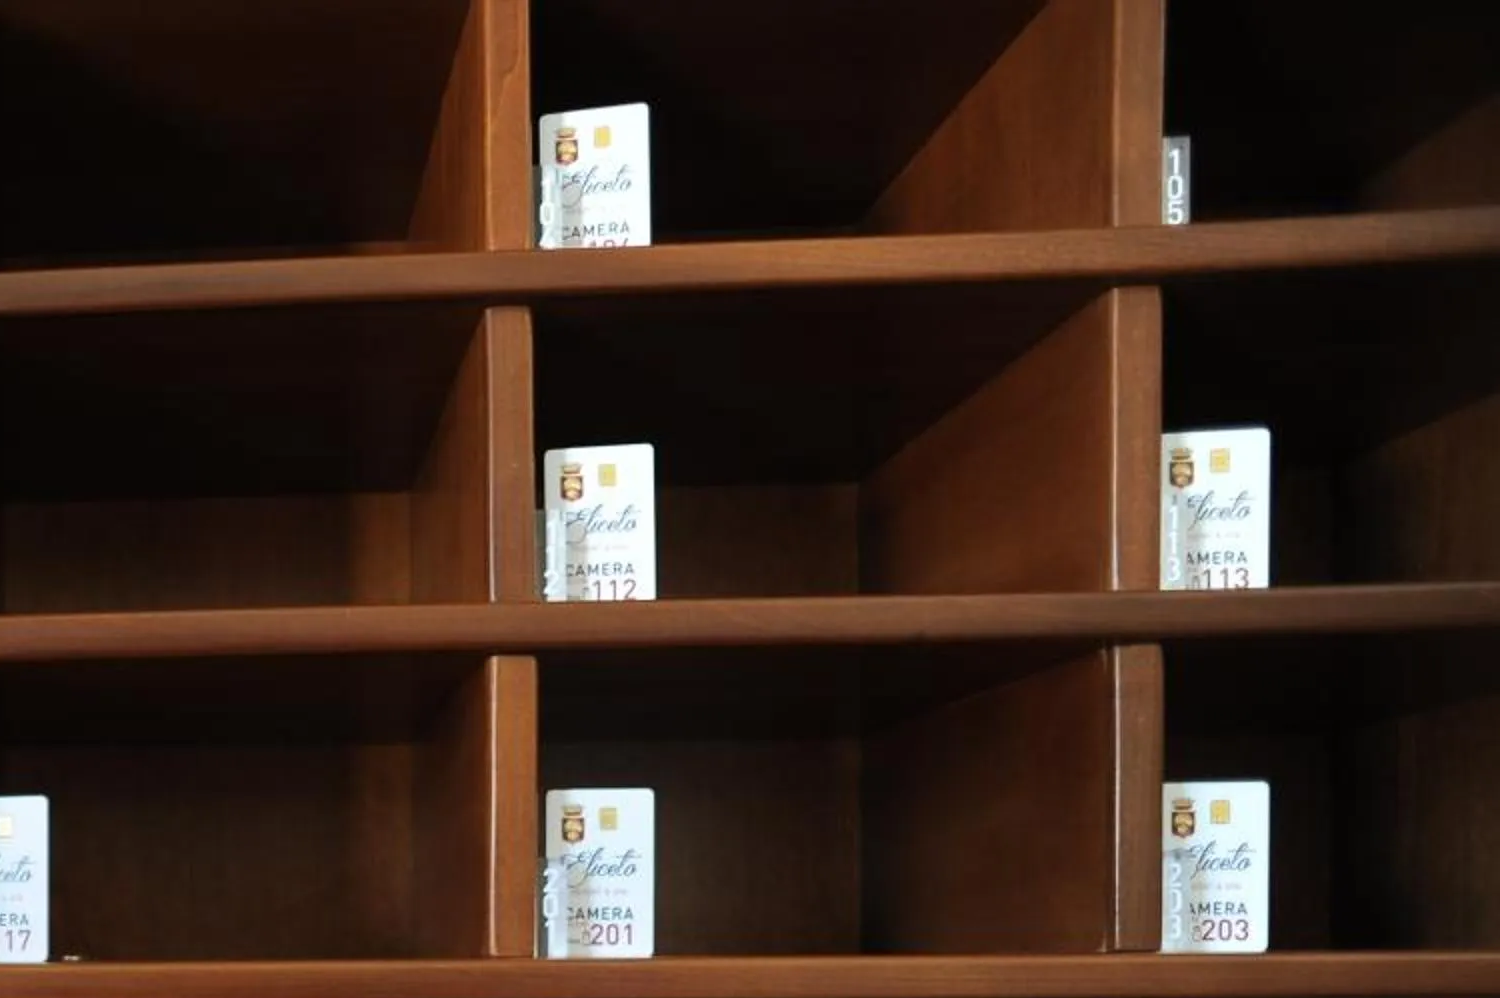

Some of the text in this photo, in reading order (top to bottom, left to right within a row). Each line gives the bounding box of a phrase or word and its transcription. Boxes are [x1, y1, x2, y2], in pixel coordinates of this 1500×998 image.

[1167, 148, 1184, 225] 105
[1186, 550, 1249, 565] AMERA
[1203, 567, 1251, 589] 113
[591, 579, 637, 600] 112
[1189, 901, 1248, 916] AMERA
[591, 923, 634, 946] 201
[1202, 919, 1249, 941] 203
